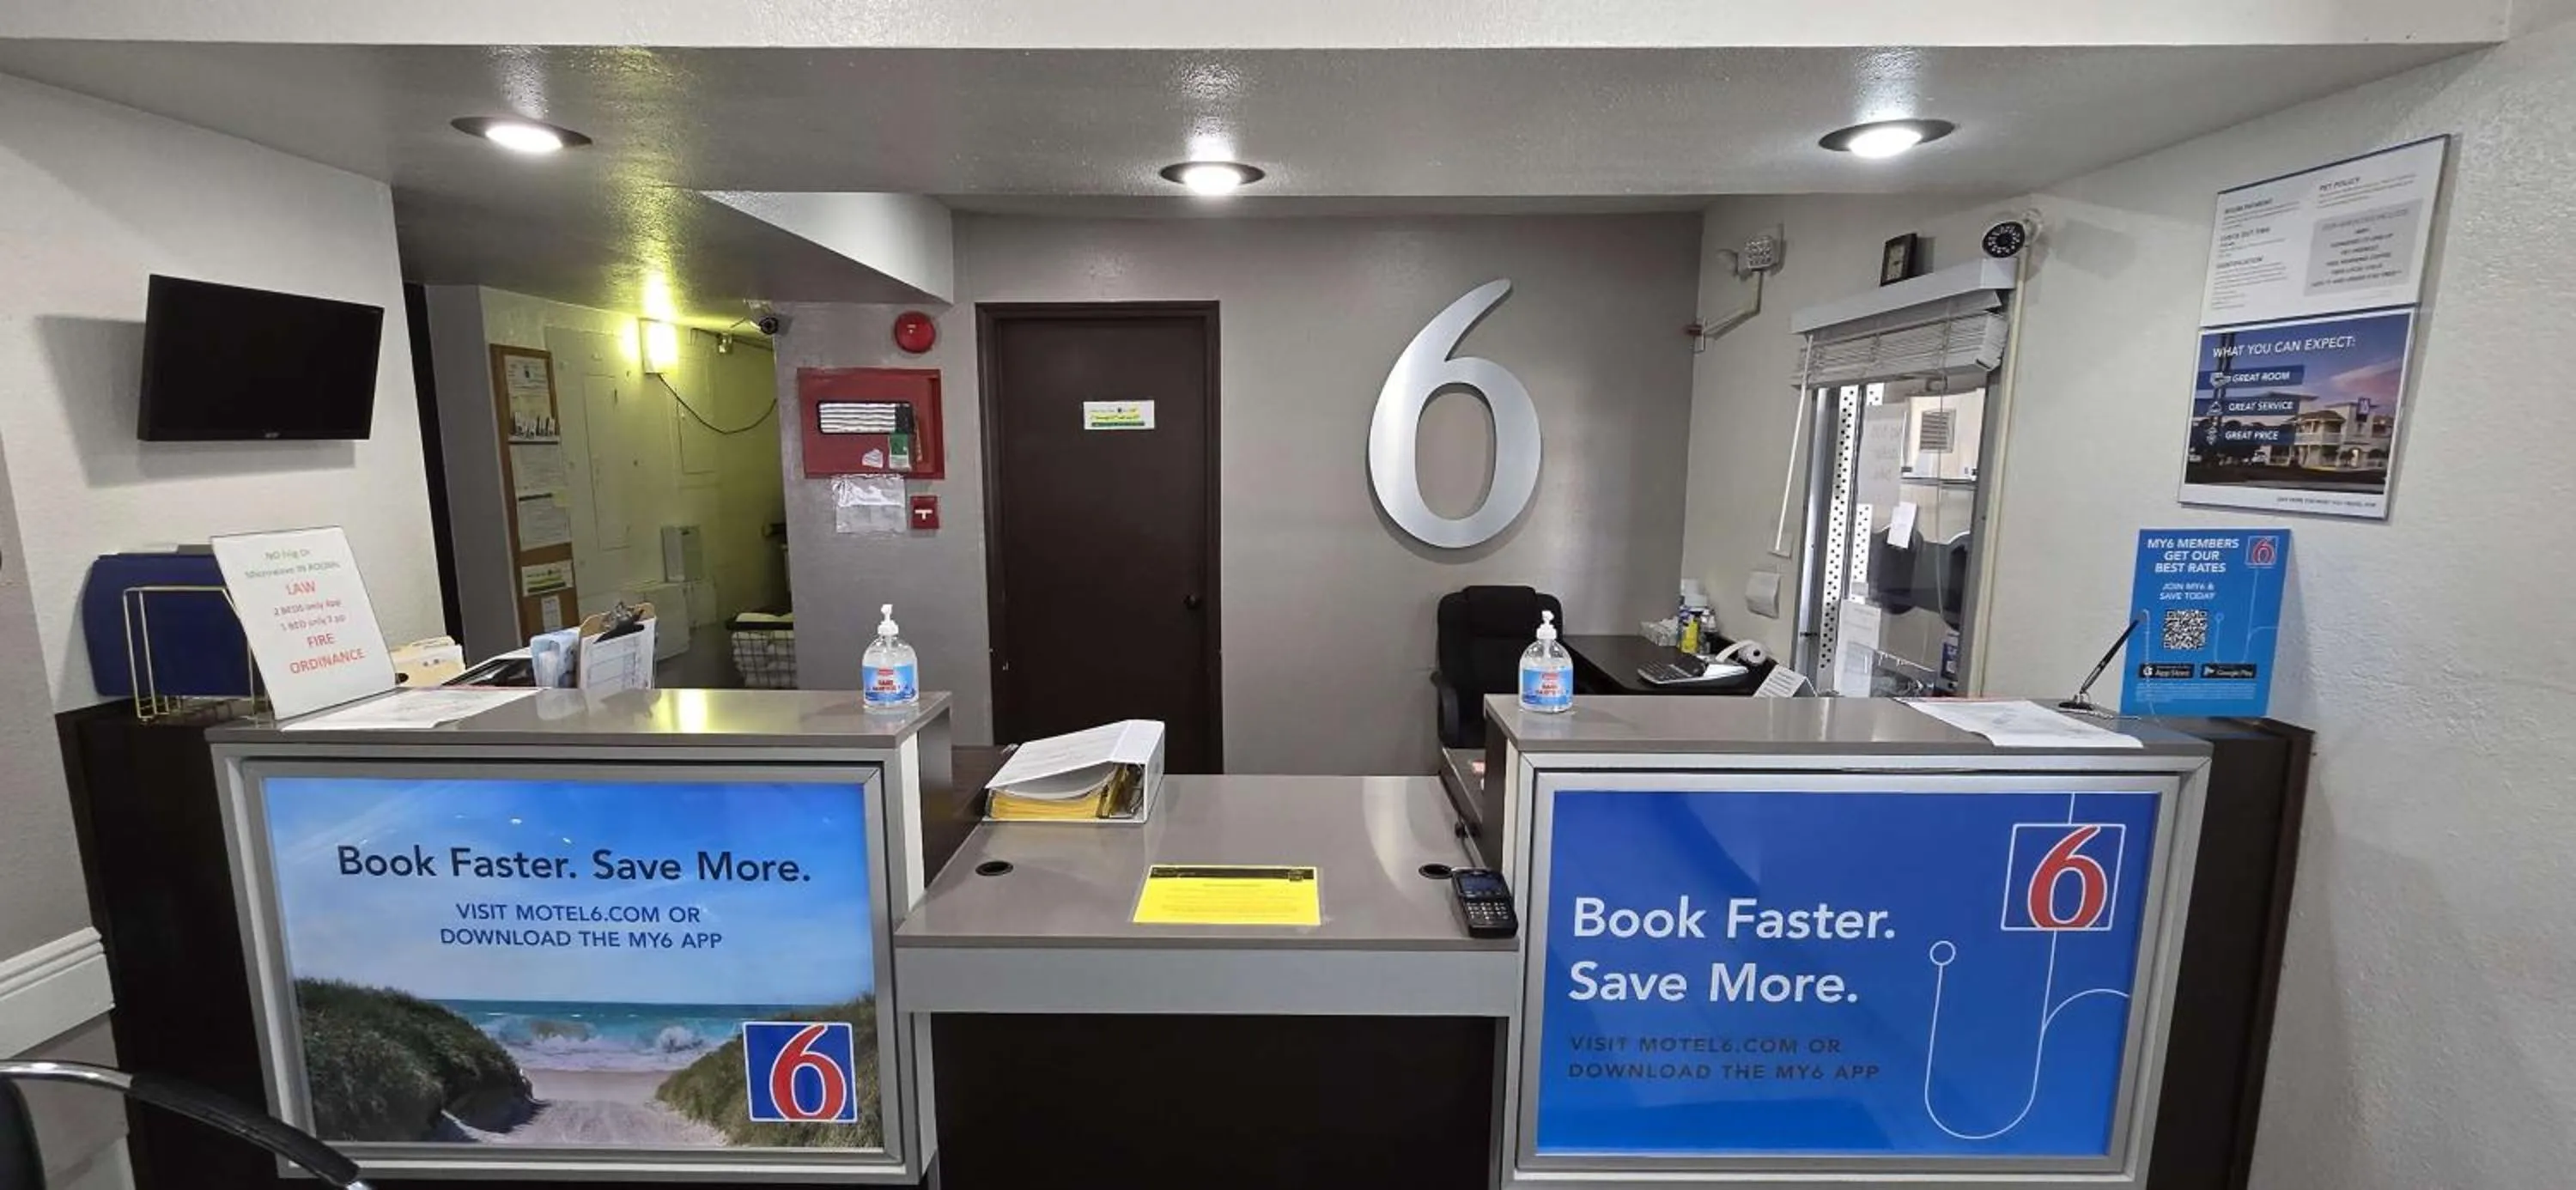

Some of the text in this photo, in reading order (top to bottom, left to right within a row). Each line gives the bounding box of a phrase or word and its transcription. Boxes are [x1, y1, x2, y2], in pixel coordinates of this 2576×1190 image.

[2213, 336, 2355, 358] WHAT YOU CAN EXPECT:
[2233, 372, 2290, 382] GREAT ROOM
[1369, 278, 1541, 549] 6
[2228, 401, 2293, 411] GREAT SERVICE
[2226, 431, 2279, 440] GREAT PRICE
[2148, 538, 2239, 549] MY6 MEMBERS
[2252, 537, 2275, 564] 6
[2164, 550, 2220, 561] GET OUR
[2154, 563, 2226, 573] BEST RATES
[286, 581, 316, 595] LAW
[2184, 592, 2216, 600] TODAY
[307, 633, 337, 647] FIRE
[289, 648, 366, 674] ORDINANCE
[337, 845, 811, 883] Book Faster. Save More.
[2027, 824, 2108, 929] 6
[456, 903, 701, 924] VISIT MOTEL6.COM OR
[1573, 896, 1896, 940] Book Faster.
[440, 928, 723, 950] DOWNLOAD THE MY6 APP
[1568, 961, 1858, 1004] Save More.
[1571, 1035, 1841, 1055] VISIT MOTEL6.COM OR
[769, 1023, 848, 1122] 6
[1568, 1062, 1880, 1081] DOWNLOAD THE MY6 APP
